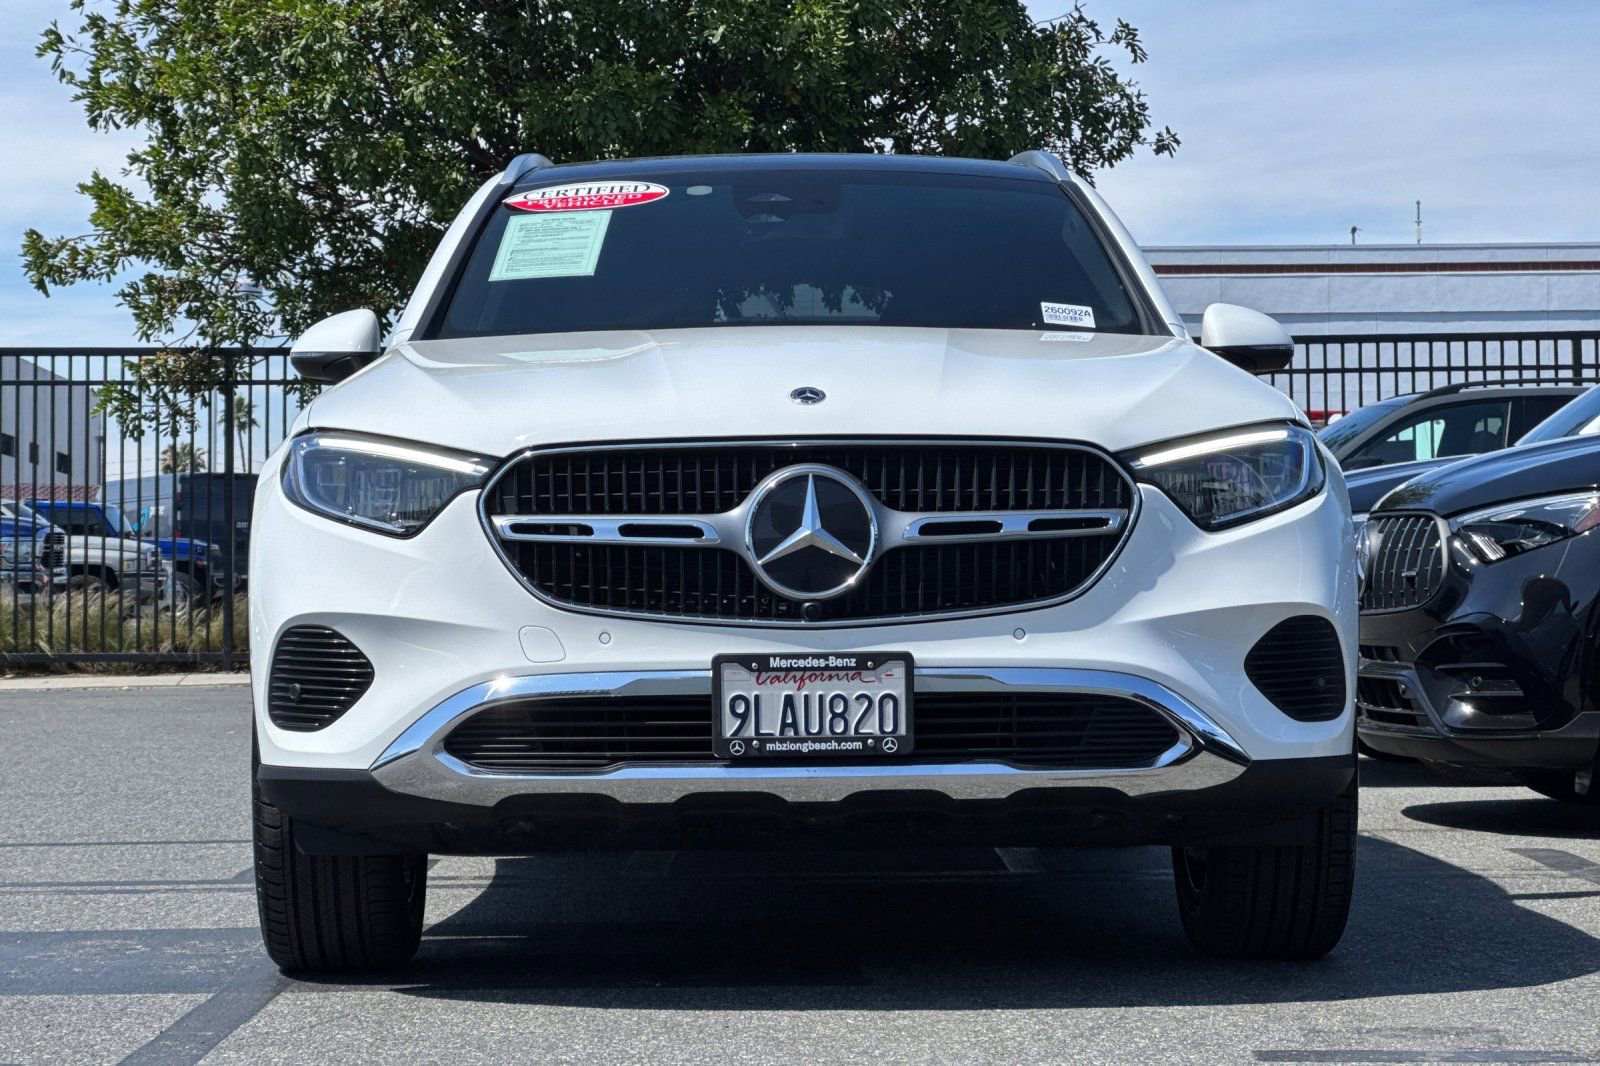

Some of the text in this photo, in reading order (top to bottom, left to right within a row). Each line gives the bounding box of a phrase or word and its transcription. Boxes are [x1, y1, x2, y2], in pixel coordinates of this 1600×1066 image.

[523, 185, 650, 199] CERTIFIED
[545, 199, 625, 209] VEHICLE
[1044, 306, 1091, 317] 260092A
[769, 656, 857, 668] Mercedes-Benz
[755, 671, 876, 691] California
[728, 693, 899, 737] 9LAU820
